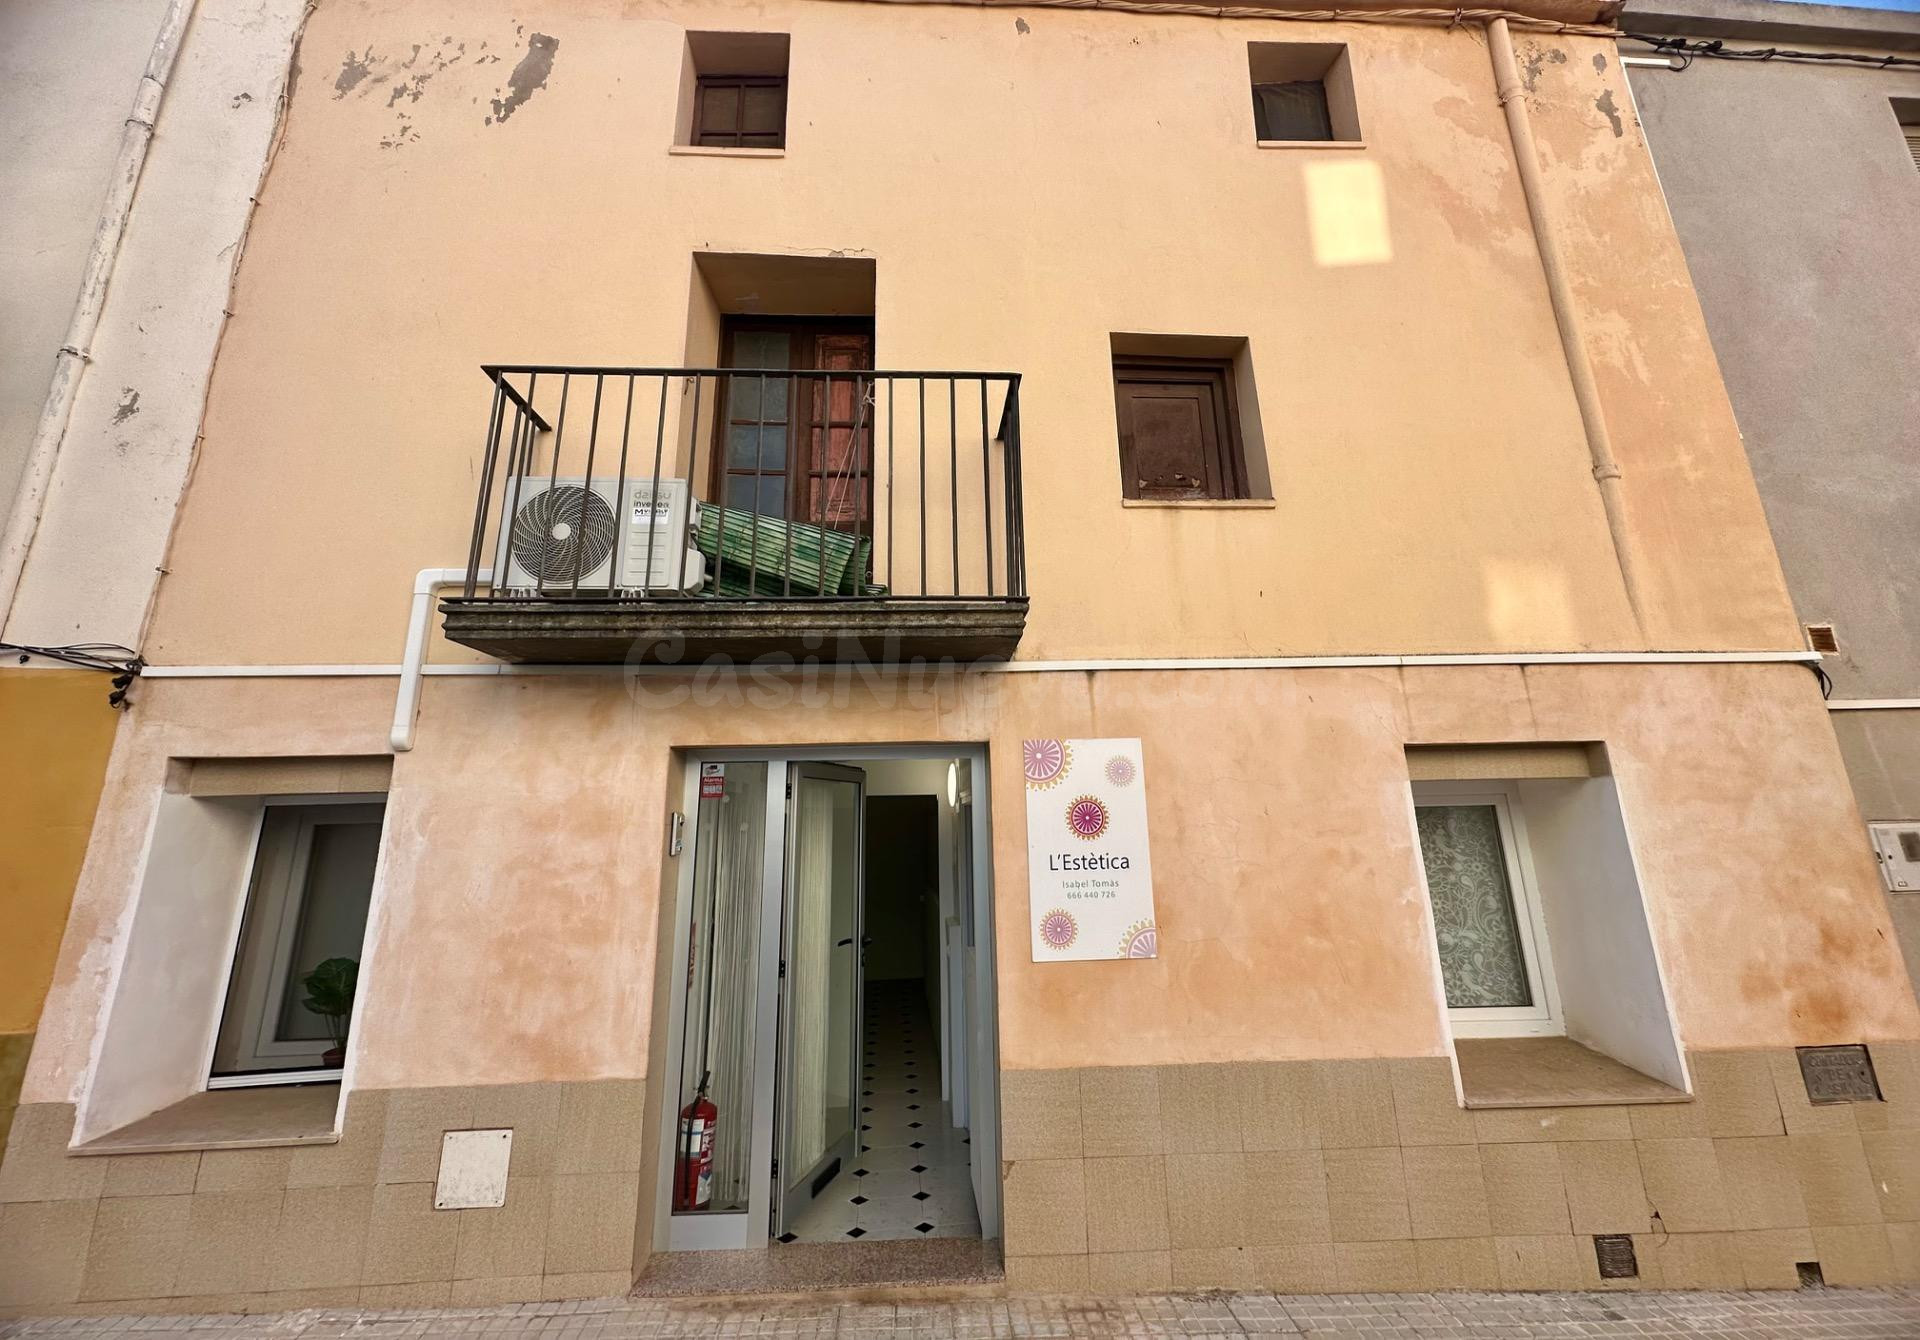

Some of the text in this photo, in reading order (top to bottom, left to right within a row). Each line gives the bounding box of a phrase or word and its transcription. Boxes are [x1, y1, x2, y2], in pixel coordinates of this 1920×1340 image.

[634, 490, 672, 500] daisu
[1049, 852, 1130, 871] L'Estètica
[1062, 879, 1089, 889] Isabel
[1067, 891, 1116, 900] 666 440 726
